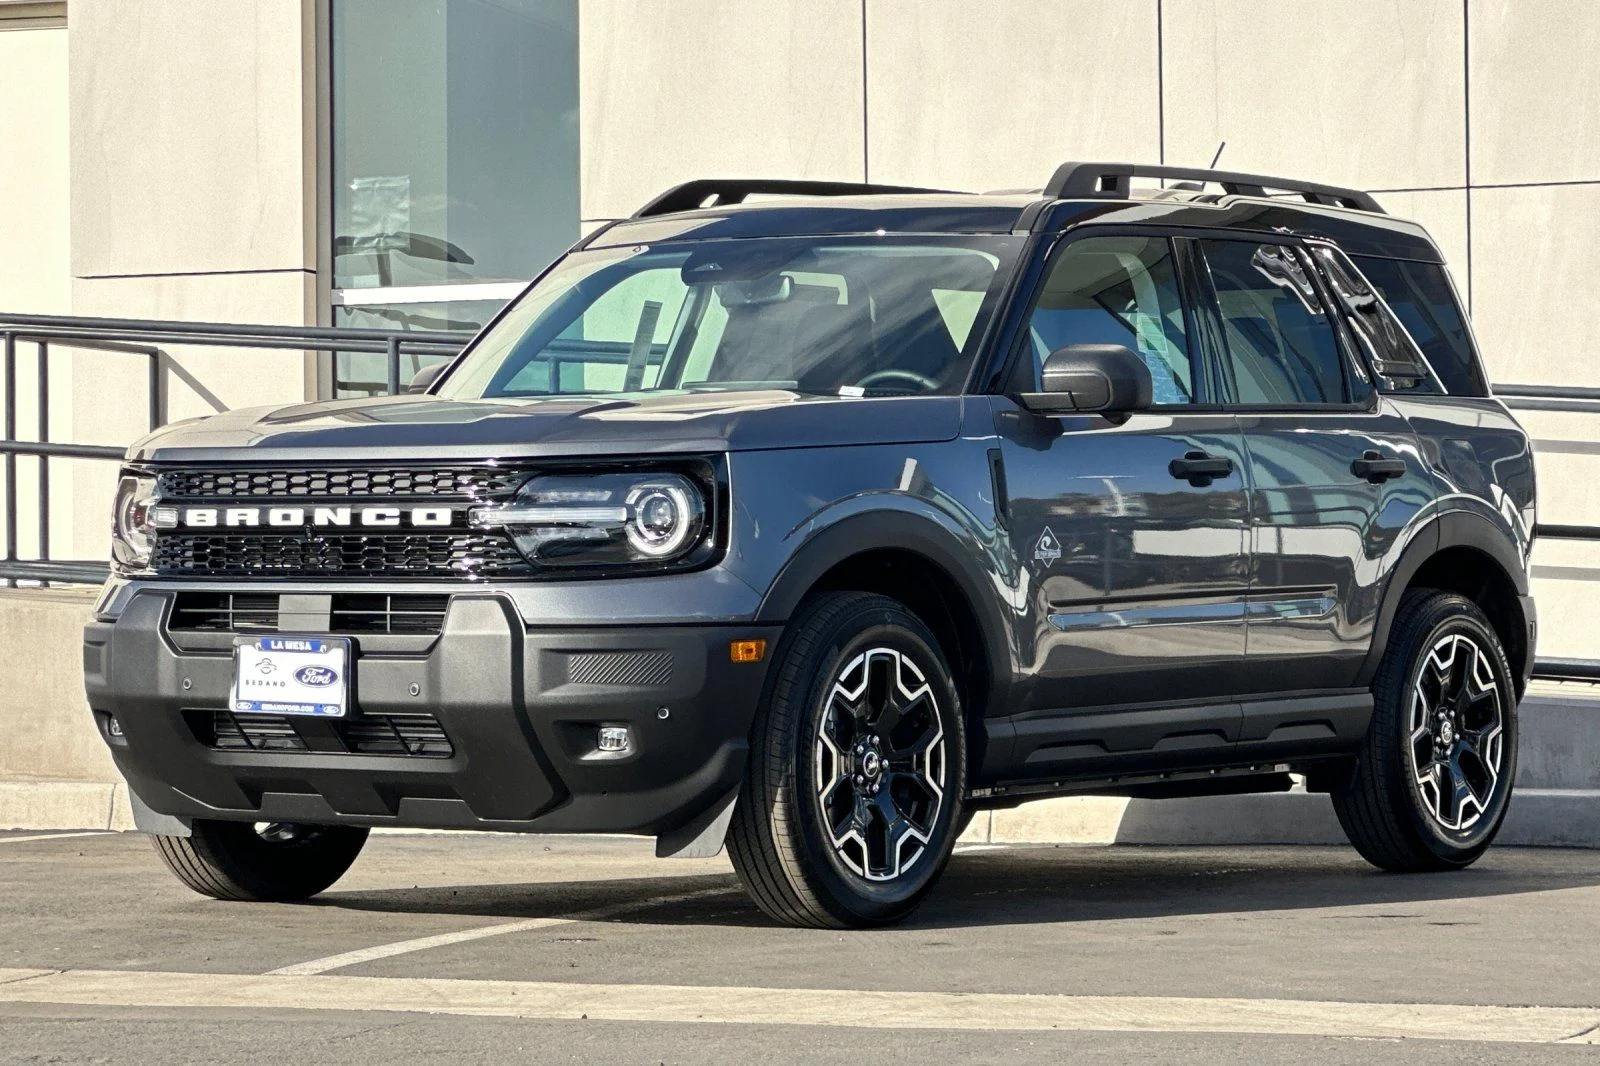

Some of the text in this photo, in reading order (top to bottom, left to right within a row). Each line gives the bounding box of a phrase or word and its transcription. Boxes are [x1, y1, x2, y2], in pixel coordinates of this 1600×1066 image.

[186, 508, 451, 526] BRONCO
[271, 641, 312, 651] LA MESA
[302, 667, 331, 684] Ford
[245, 680, 286, 688] SEDANO
